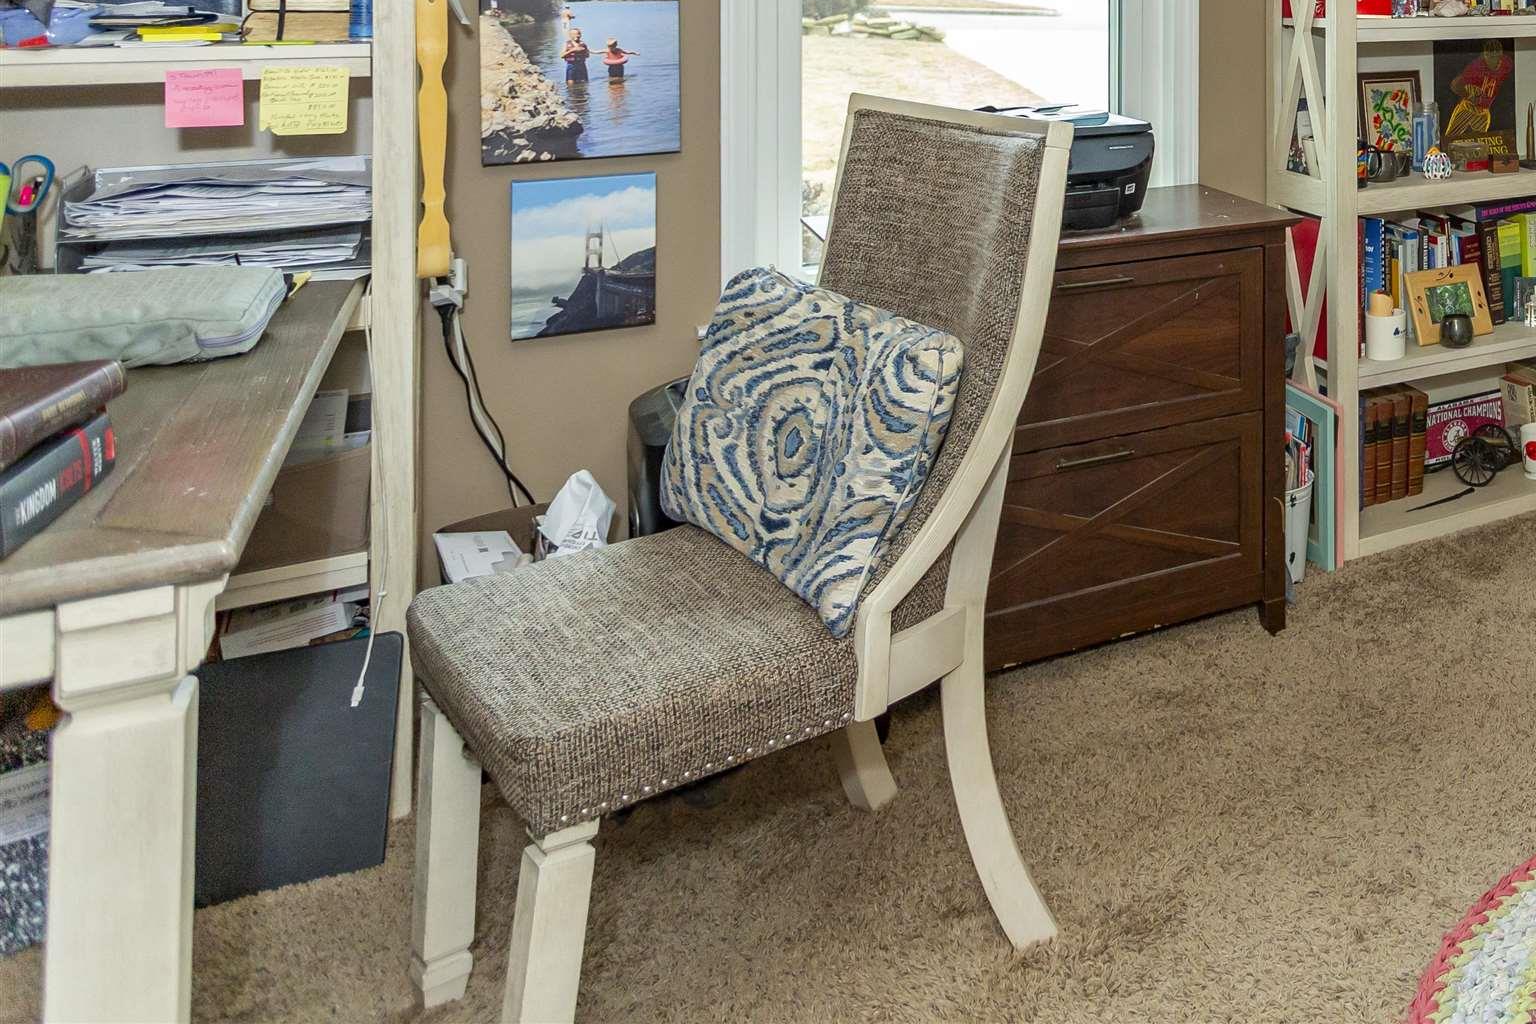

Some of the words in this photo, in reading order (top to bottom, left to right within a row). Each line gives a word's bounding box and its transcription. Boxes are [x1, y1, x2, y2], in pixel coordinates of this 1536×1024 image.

[1426, 408, 1463, 427] NATIONAL
[1463, 399, 1502, 421] CHAMPIONS
[19, 478, 58, 527] KINGDOM
